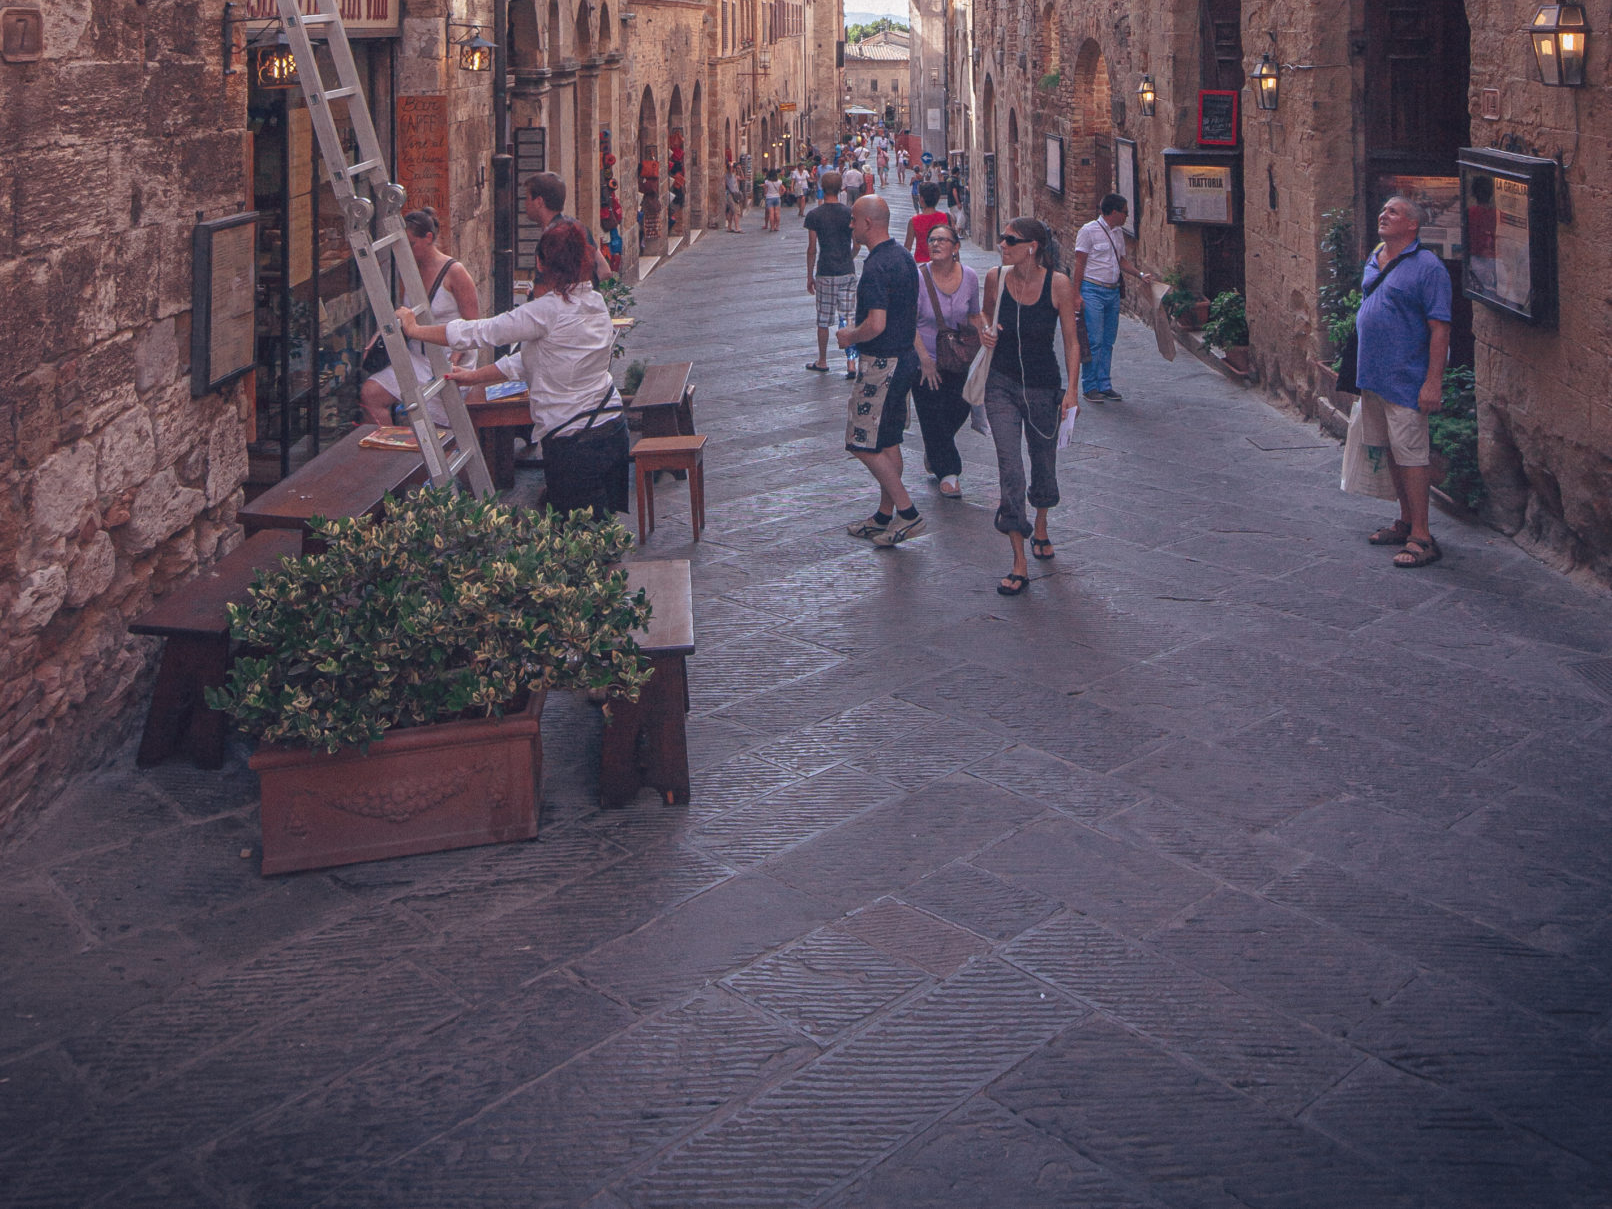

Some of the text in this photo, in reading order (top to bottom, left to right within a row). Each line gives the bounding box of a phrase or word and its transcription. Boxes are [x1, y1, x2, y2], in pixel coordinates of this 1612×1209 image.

[16, 18, 28, 50] 7
[1188, 177, 1223, 189] TRATTORIA
[1496, 178, 1502, 192] LA
